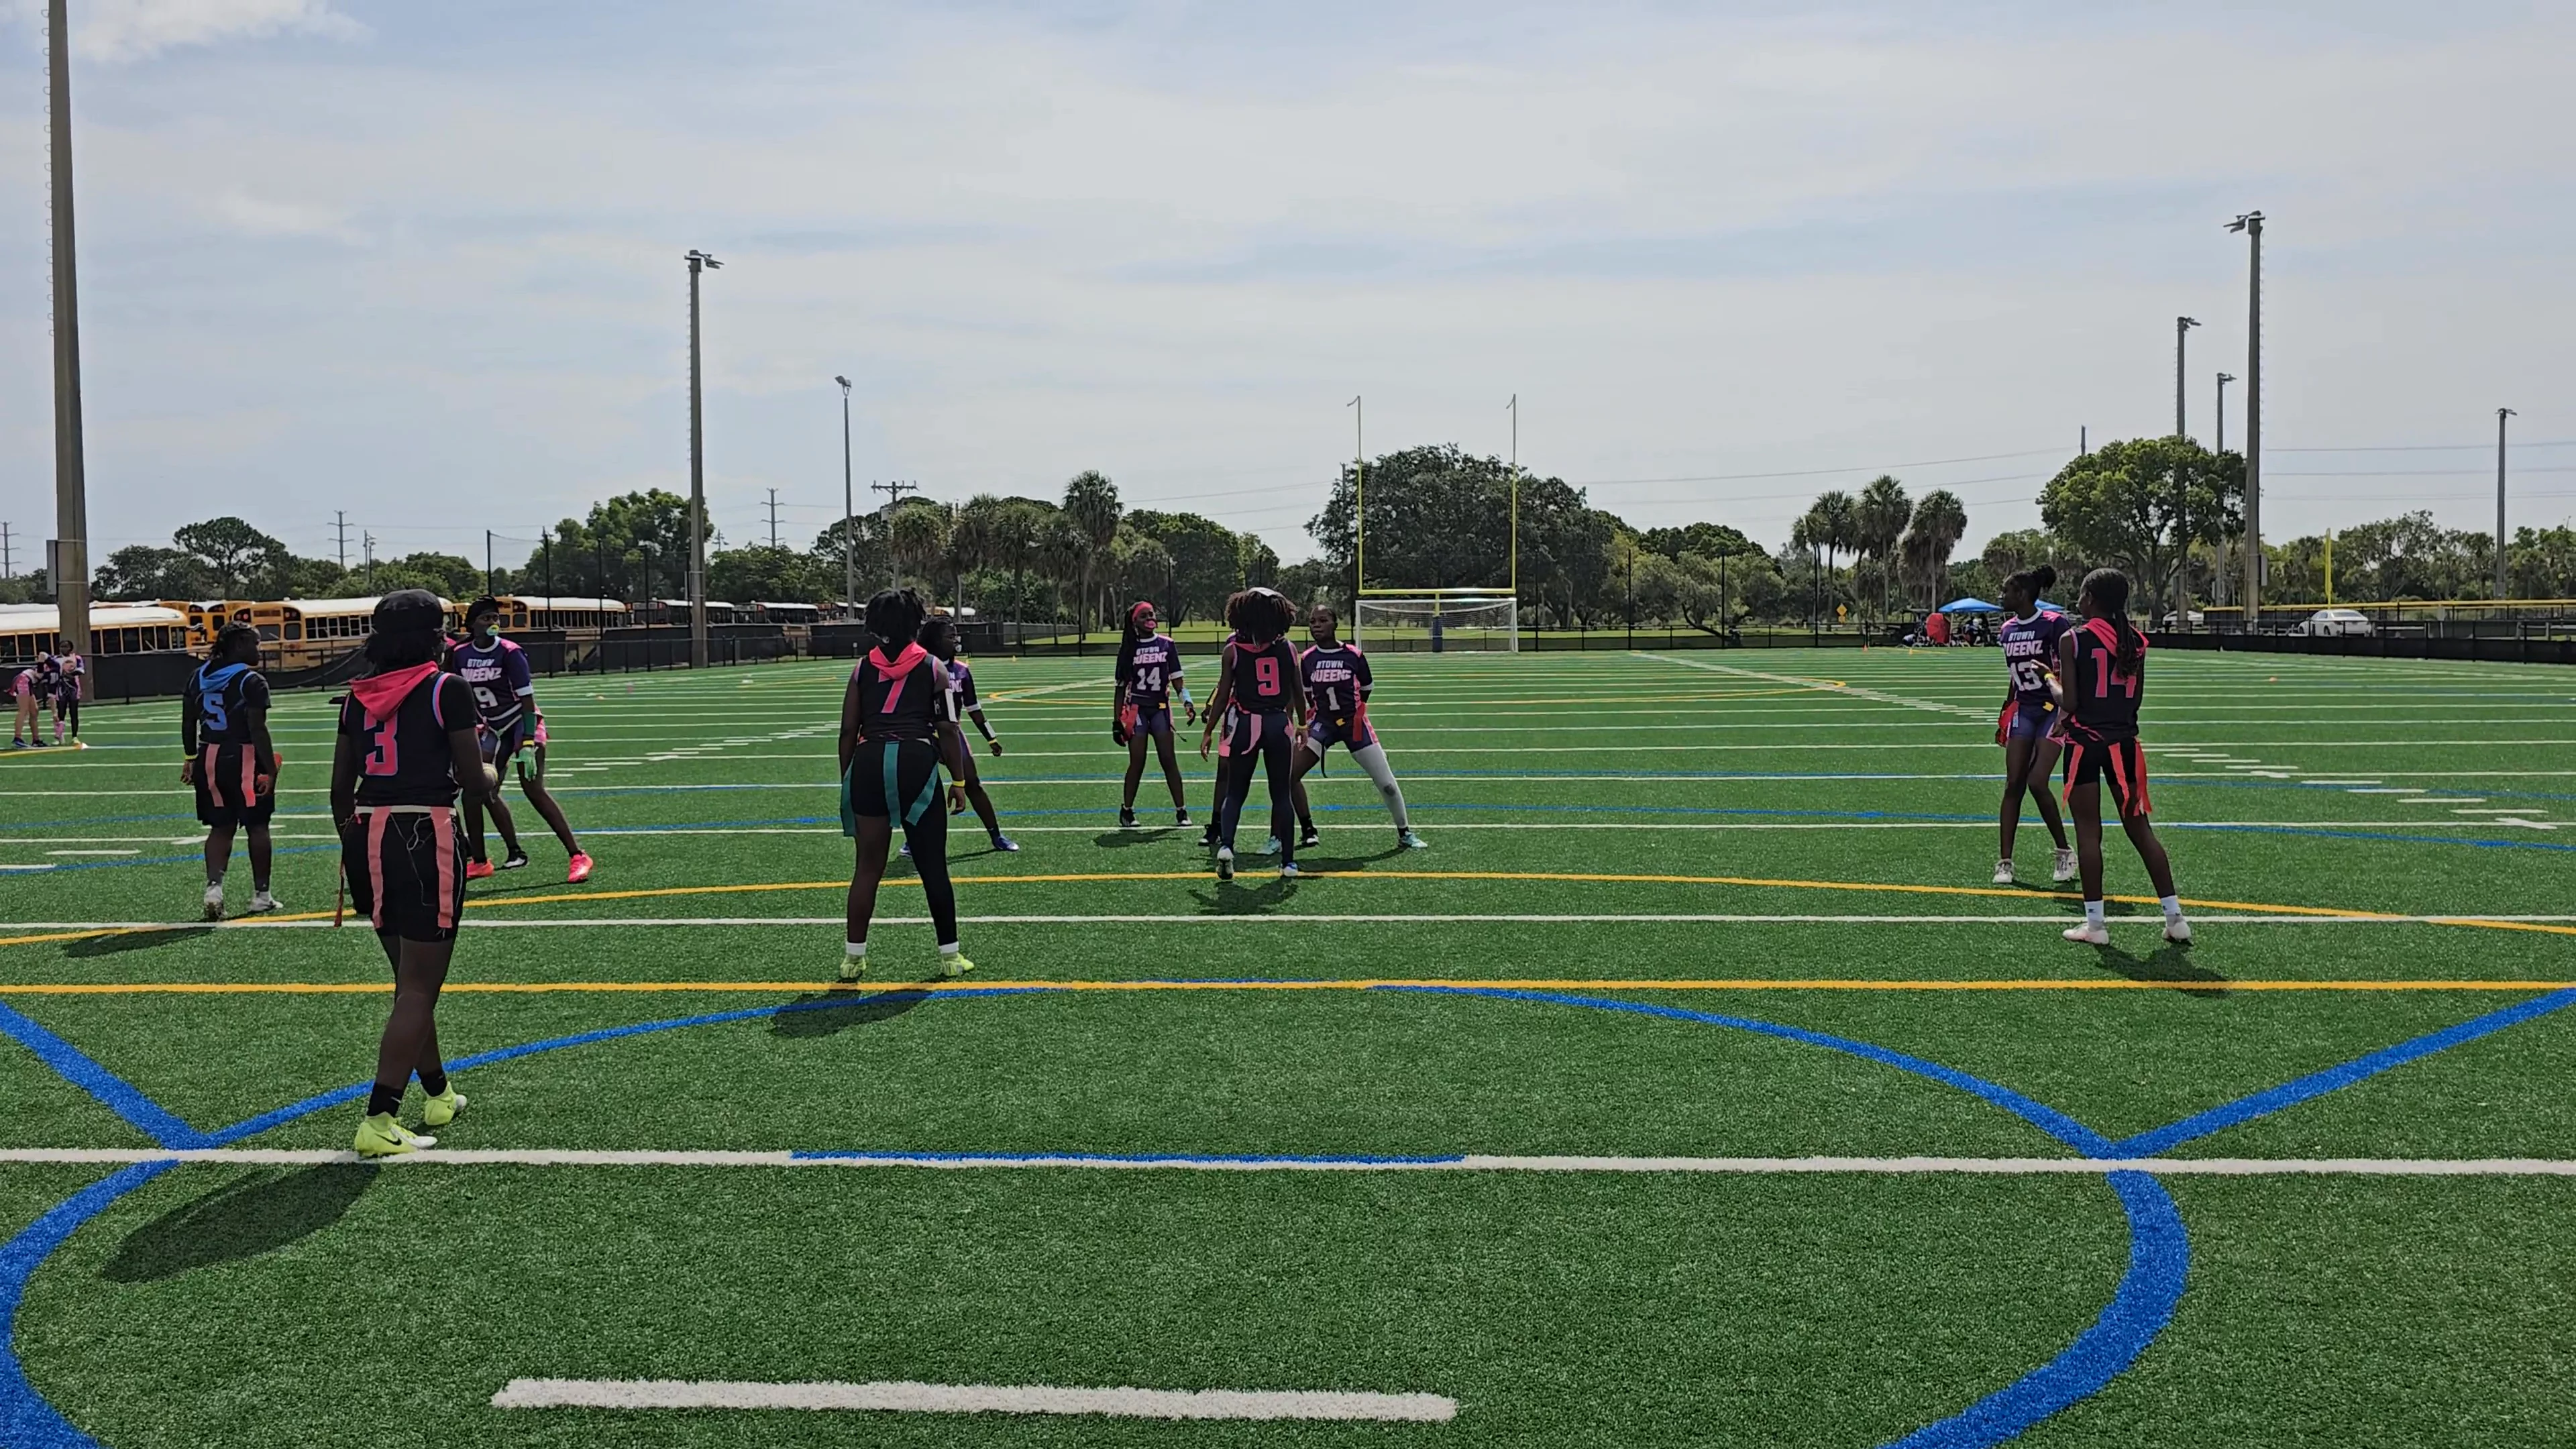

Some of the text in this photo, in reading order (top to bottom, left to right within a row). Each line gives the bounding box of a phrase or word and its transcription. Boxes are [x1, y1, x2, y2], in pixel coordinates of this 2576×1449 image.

[878, 670, 909, 713] 7
[1136, 667, 1161, 691] 14
[1255, 657, 1281, 696] 9
[2010, 661, 2043, 691] 13
[203, 692, 227, 731] 5
[473, 686, 498, 708] 9
[1326, 686, 1340, 710] 1
[364, 708, 398, 776] 3
